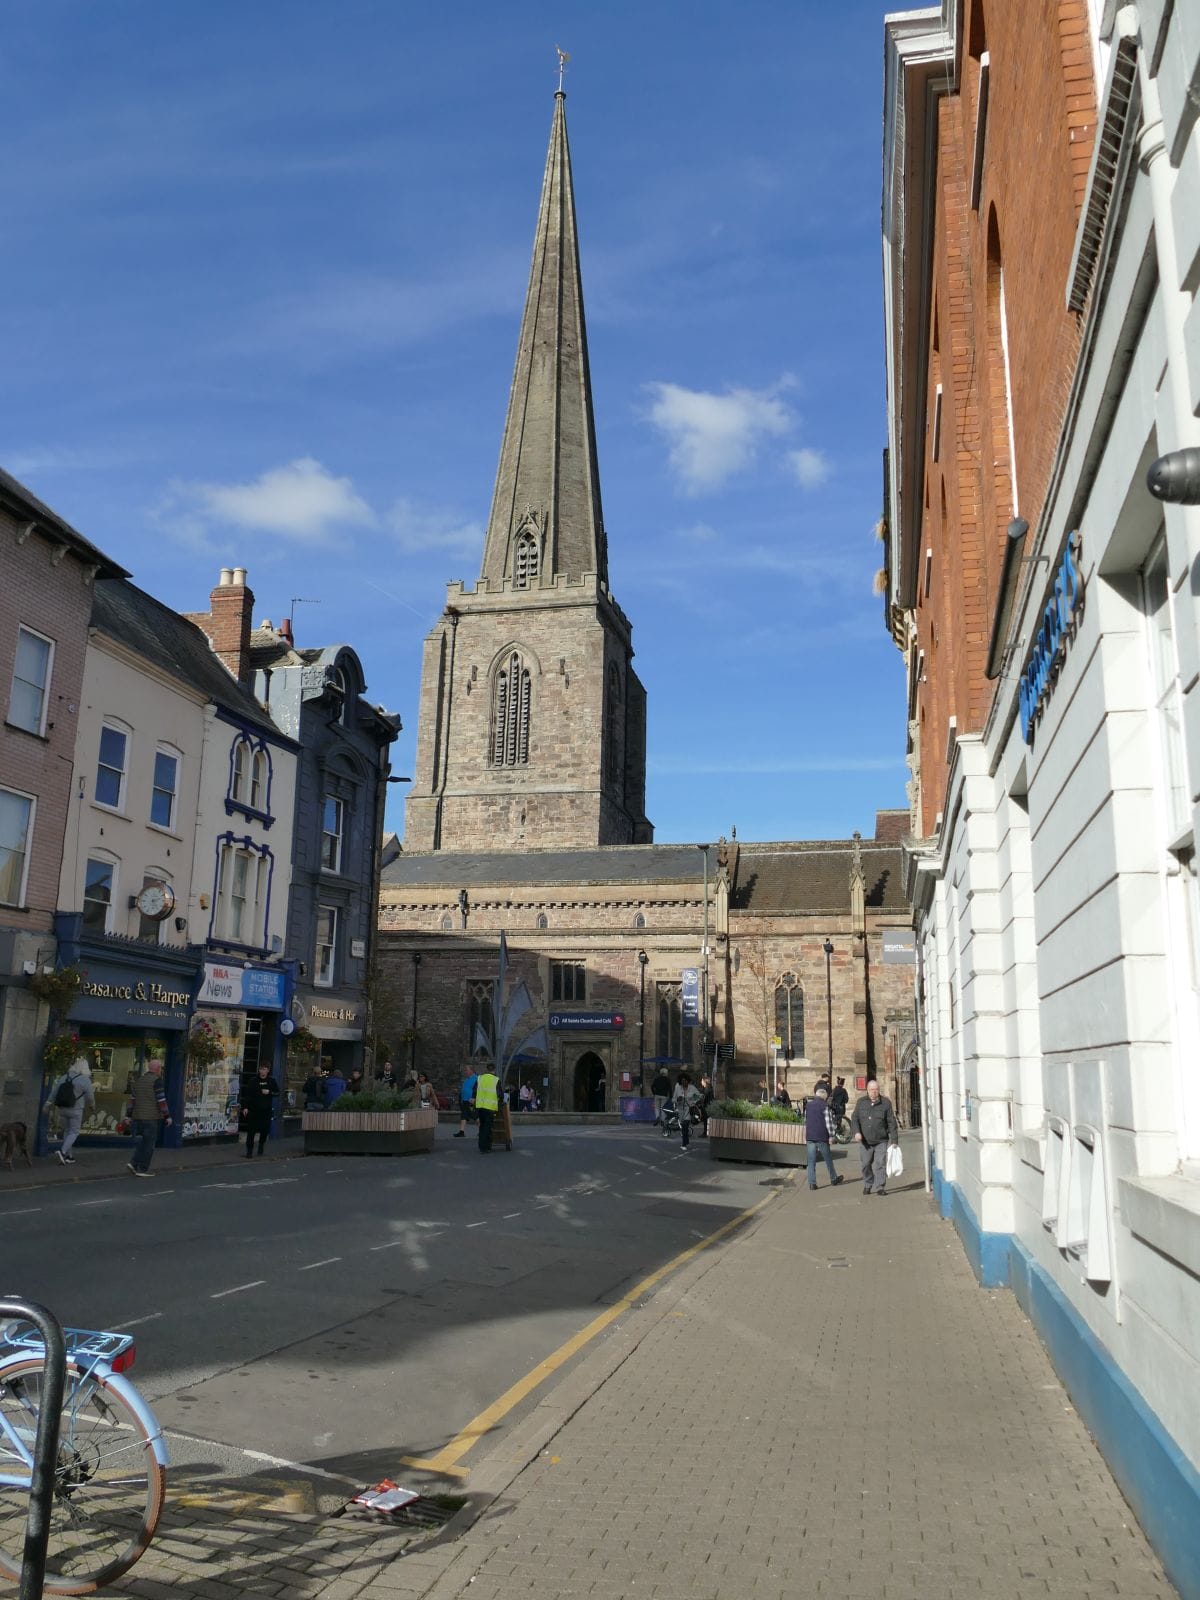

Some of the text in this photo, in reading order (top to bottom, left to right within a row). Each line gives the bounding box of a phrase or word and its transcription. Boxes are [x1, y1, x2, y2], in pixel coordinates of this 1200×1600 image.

[250, 972, 279, 985] MOBILE
[135, 981, 148, 1001] &
[150, 982, 190, 1009] Harper
[206, 979, 232, 998] News
[248, 983, 279, 997] STATION
[311, 1005, 338, 1019] Pleasance
